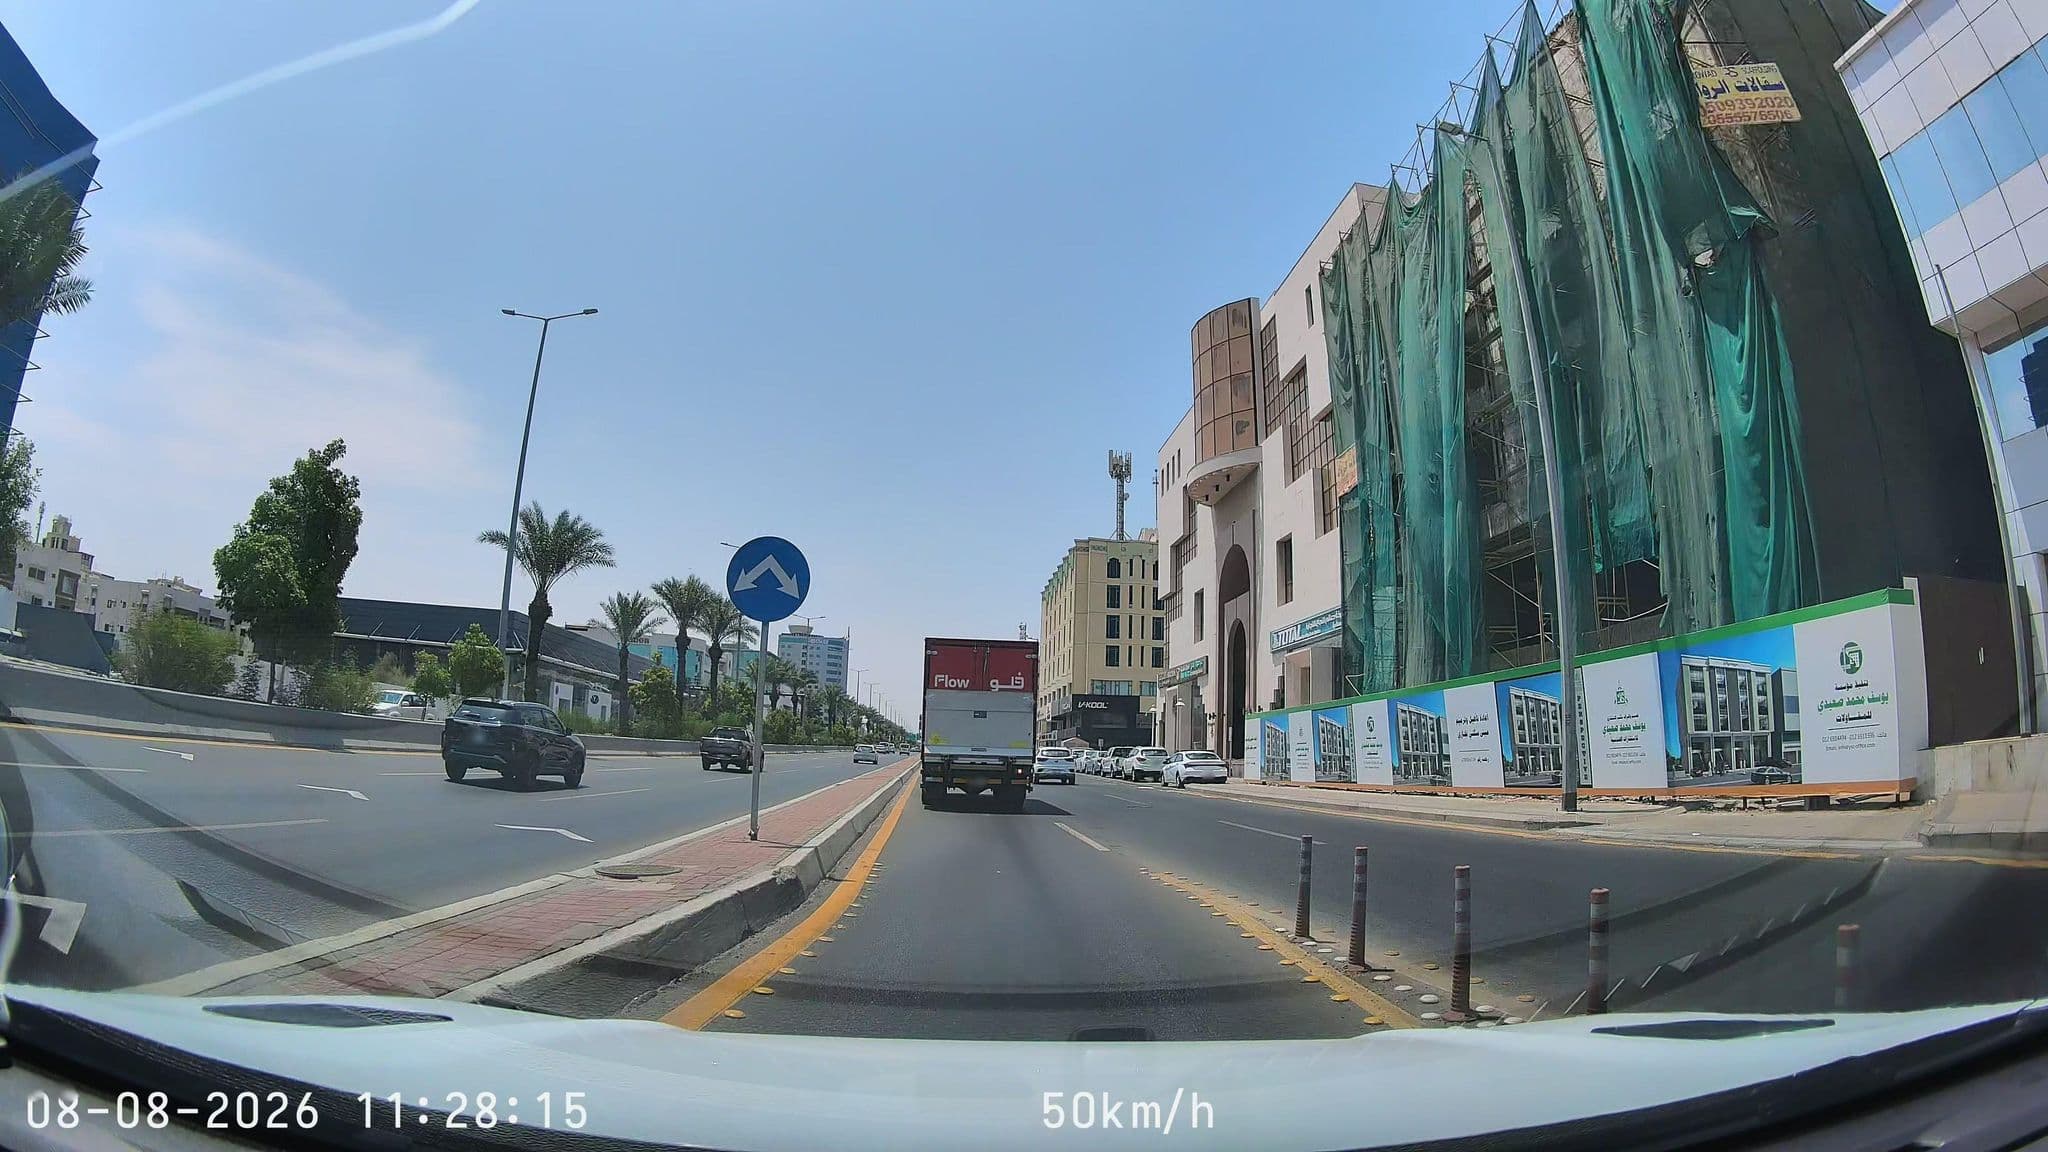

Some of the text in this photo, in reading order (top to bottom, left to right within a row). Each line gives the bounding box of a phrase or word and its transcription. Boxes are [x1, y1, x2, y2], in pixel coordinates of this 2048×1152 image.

[1735, 76, 1785, 92] سقالات
[934, 674, 970, 688] Flow
[990, 671, 1025, 692] فلو
[1846, 695, 1865, 706] محمد
[1867, 690, 1889, 705] يوسف
[1078, 701, 1108, 709] V-KOOL
[1835, 710, 1872, 723] للمقاولات
